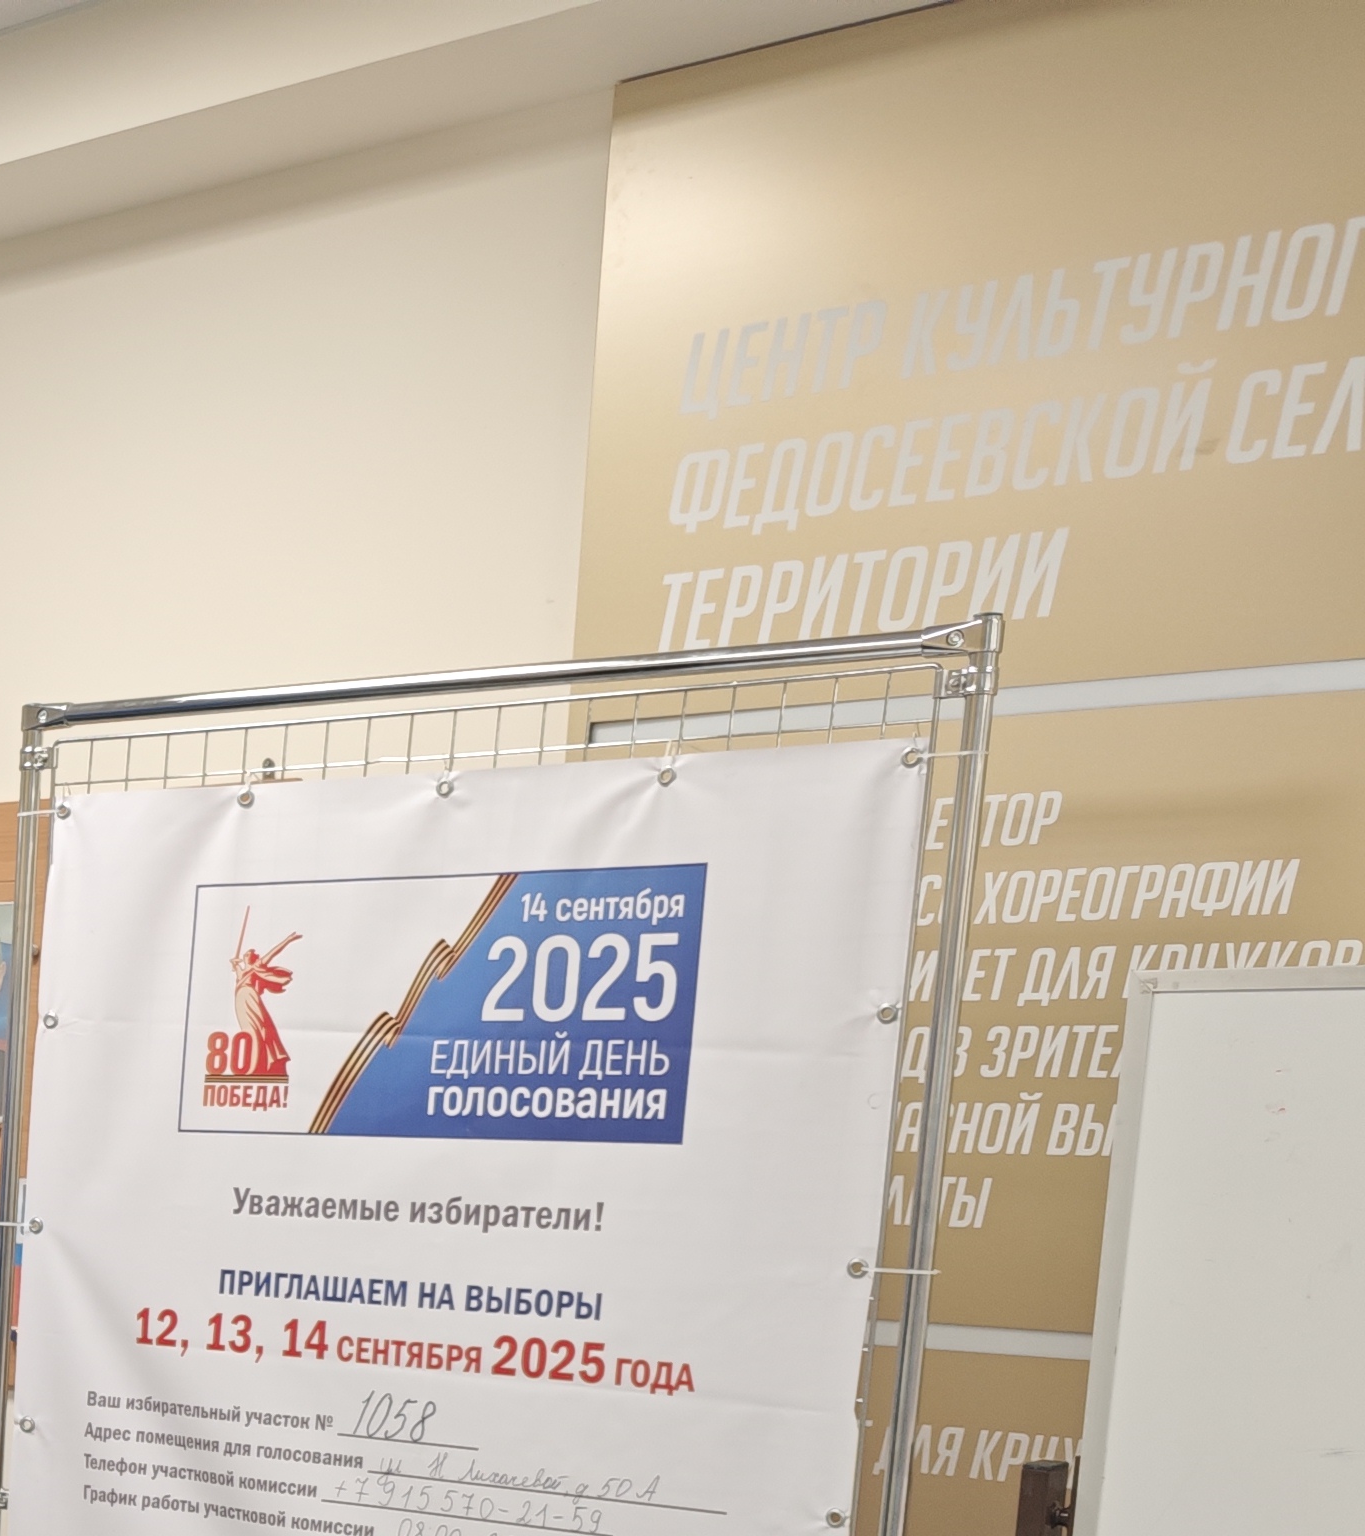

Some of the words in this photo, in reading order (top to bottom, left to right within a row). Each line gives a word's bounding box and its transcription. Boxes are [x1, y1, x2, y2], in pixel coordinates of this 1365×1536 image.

[680, 298, 888, 422] ЦЕНТР
[668, 358, 1217, 534] ФЕДОСЕЕВСКОЙ
[657, 526, 1070, 654] ТЕРРИТОРИИ
[520, 892, 547, 922] 14
[555, 888, 685, 925] сентября
[973, 858, 1299, 926] ХОРЕОГРАФИИ
[481, 932, 679, 1023] 2025
[1016, 945, 1117, 1007] ДЛЯ
[205, 1031, 258, 1076] 80
[430, 1031, 571, 1080] ЕДИНЫЙ
[578, 1038, 669, 1080] ДЕНЬ
[203, 1084, 288, 1111] ПОБЕДА!
[427, 1085, 667, 1120] голосования
[232, 1186, 400, 1223] Уважаемые
[409, 1195, 605, 1234] избиратели!
[218, 1268, 408, 1308] ПРИГЛАШАЕМ
[417, 1281, 455, 1311] НА
[464, 1284, 603, 1321] ВЫБОРЫ
[136, 1307, 189, 1357] 12,
[205, 1312, 264, 1364] 13,
[282, 1318, 329, 1360] 14
[336, 1335, 483, 1374] СЕНТЯБРЯ
[491, 1334, 606, 1384] 2025
[614, 1357, 695, 1397] ГОДА
[86, 1390, 122, 1409] Ваш
[125, 1395, 241, 1423] избирательный
[244, 1410, 311, 1430] участок
[314, 1413, 334, 1432] №
[353, 1390, 437, 1443] 1058
[84, 1421, 132, 1443] Адрес
[135, 1430, 220, 1453] помещения
[222, 1441, 252, 1458] для
[256, 1445, 363, 1470] голосования
[83, 1452, 148, 1477] Телефон
[150, 1464, 235, 1488] участковой
[238, 1476, 316, 1498] комиссии
[83, 1484, 138, 1508] График
[141, 1494, 200, 1514] работы
[203, 1502, 287, 1528] участковой
